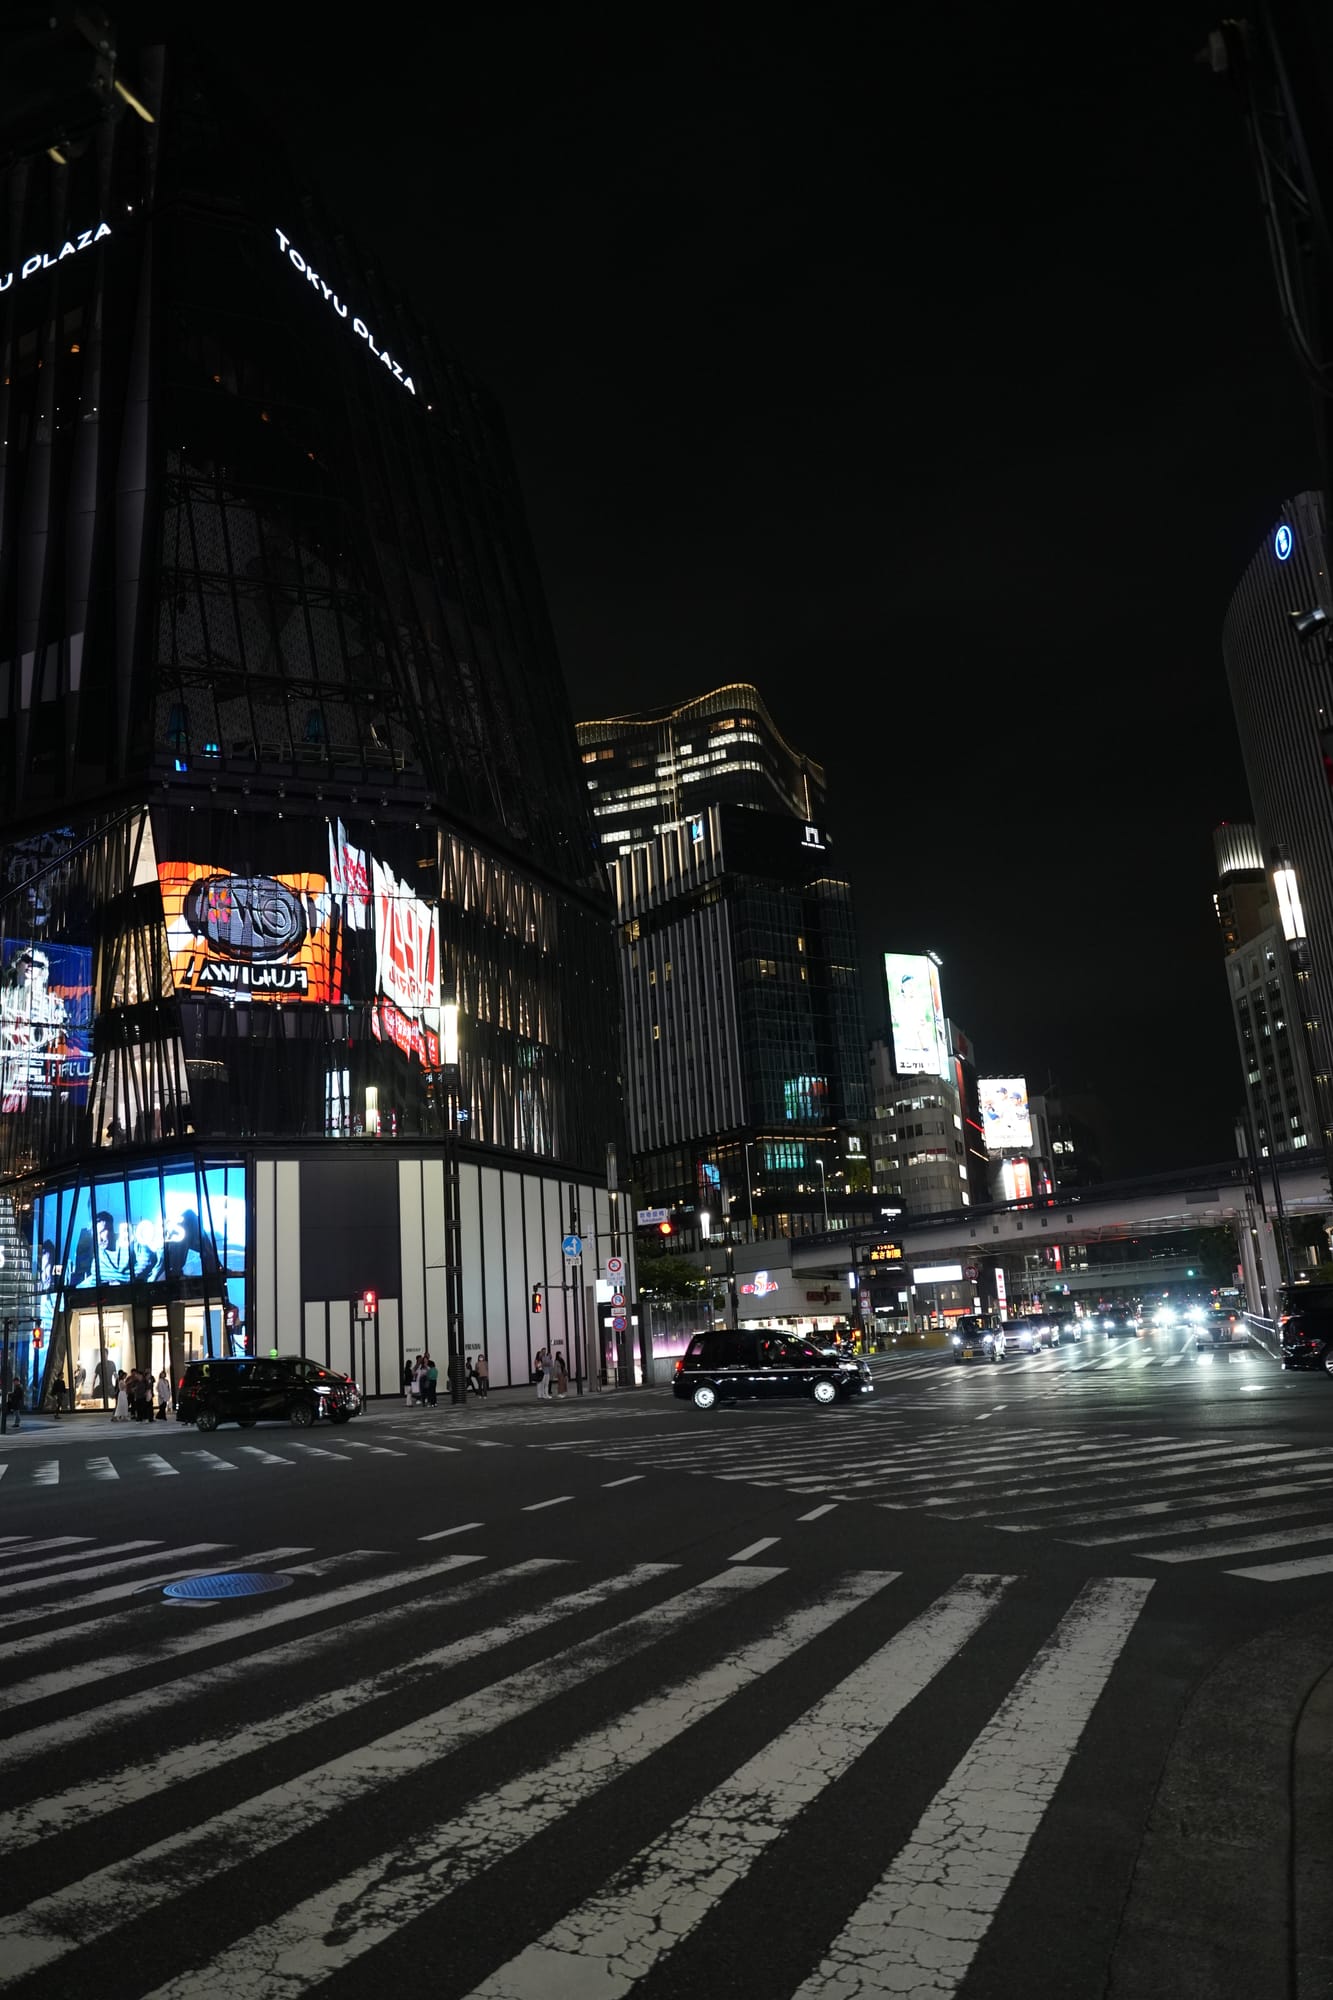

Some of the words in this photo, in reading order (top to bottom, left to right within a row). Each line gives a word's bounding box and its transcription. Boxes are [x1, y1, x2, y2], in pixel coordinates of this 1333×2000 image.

[21, 222, 112, 280] PLAZA
[275, 227, 348, 318] TOKYU
[353, 317, 416, 396] PLAZA
